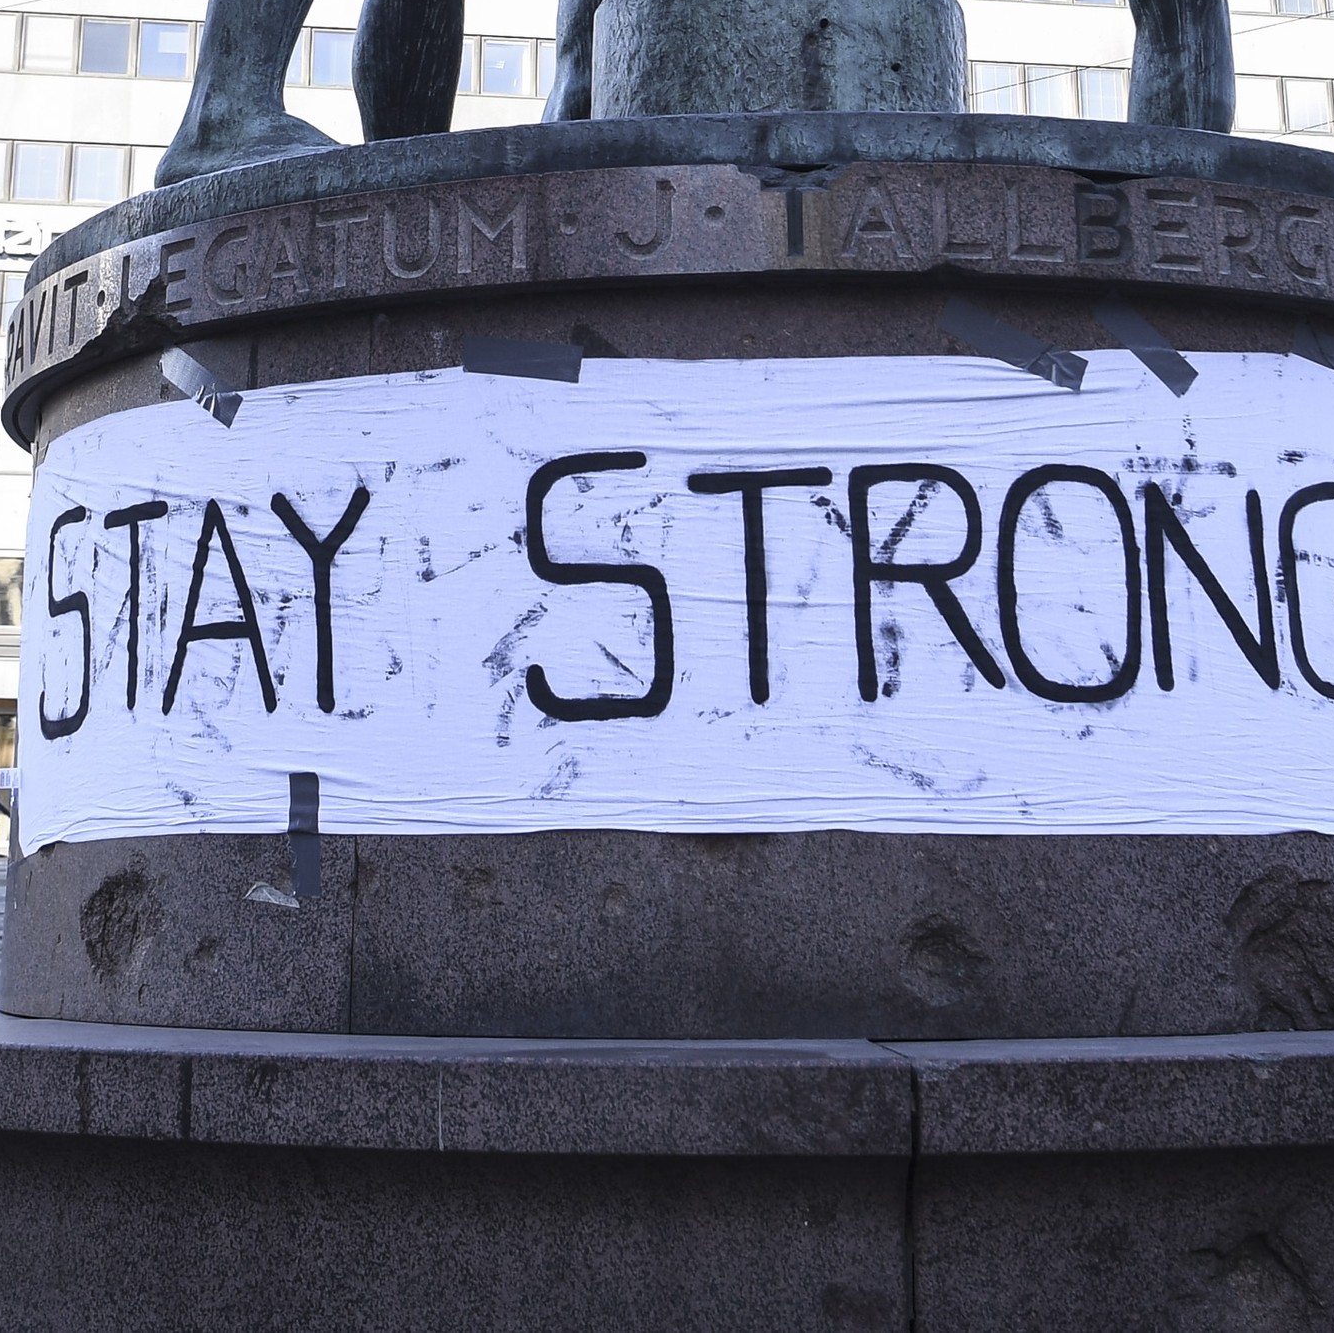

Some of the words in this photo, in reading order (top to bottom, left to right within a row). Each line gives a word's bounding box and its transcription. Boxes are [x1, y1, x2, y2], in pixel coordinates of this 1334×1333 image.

[121, 193, 528, 317] LEGATUM
[617, 180, 673, 258] J
[39, 486, 371, 740] STAY
